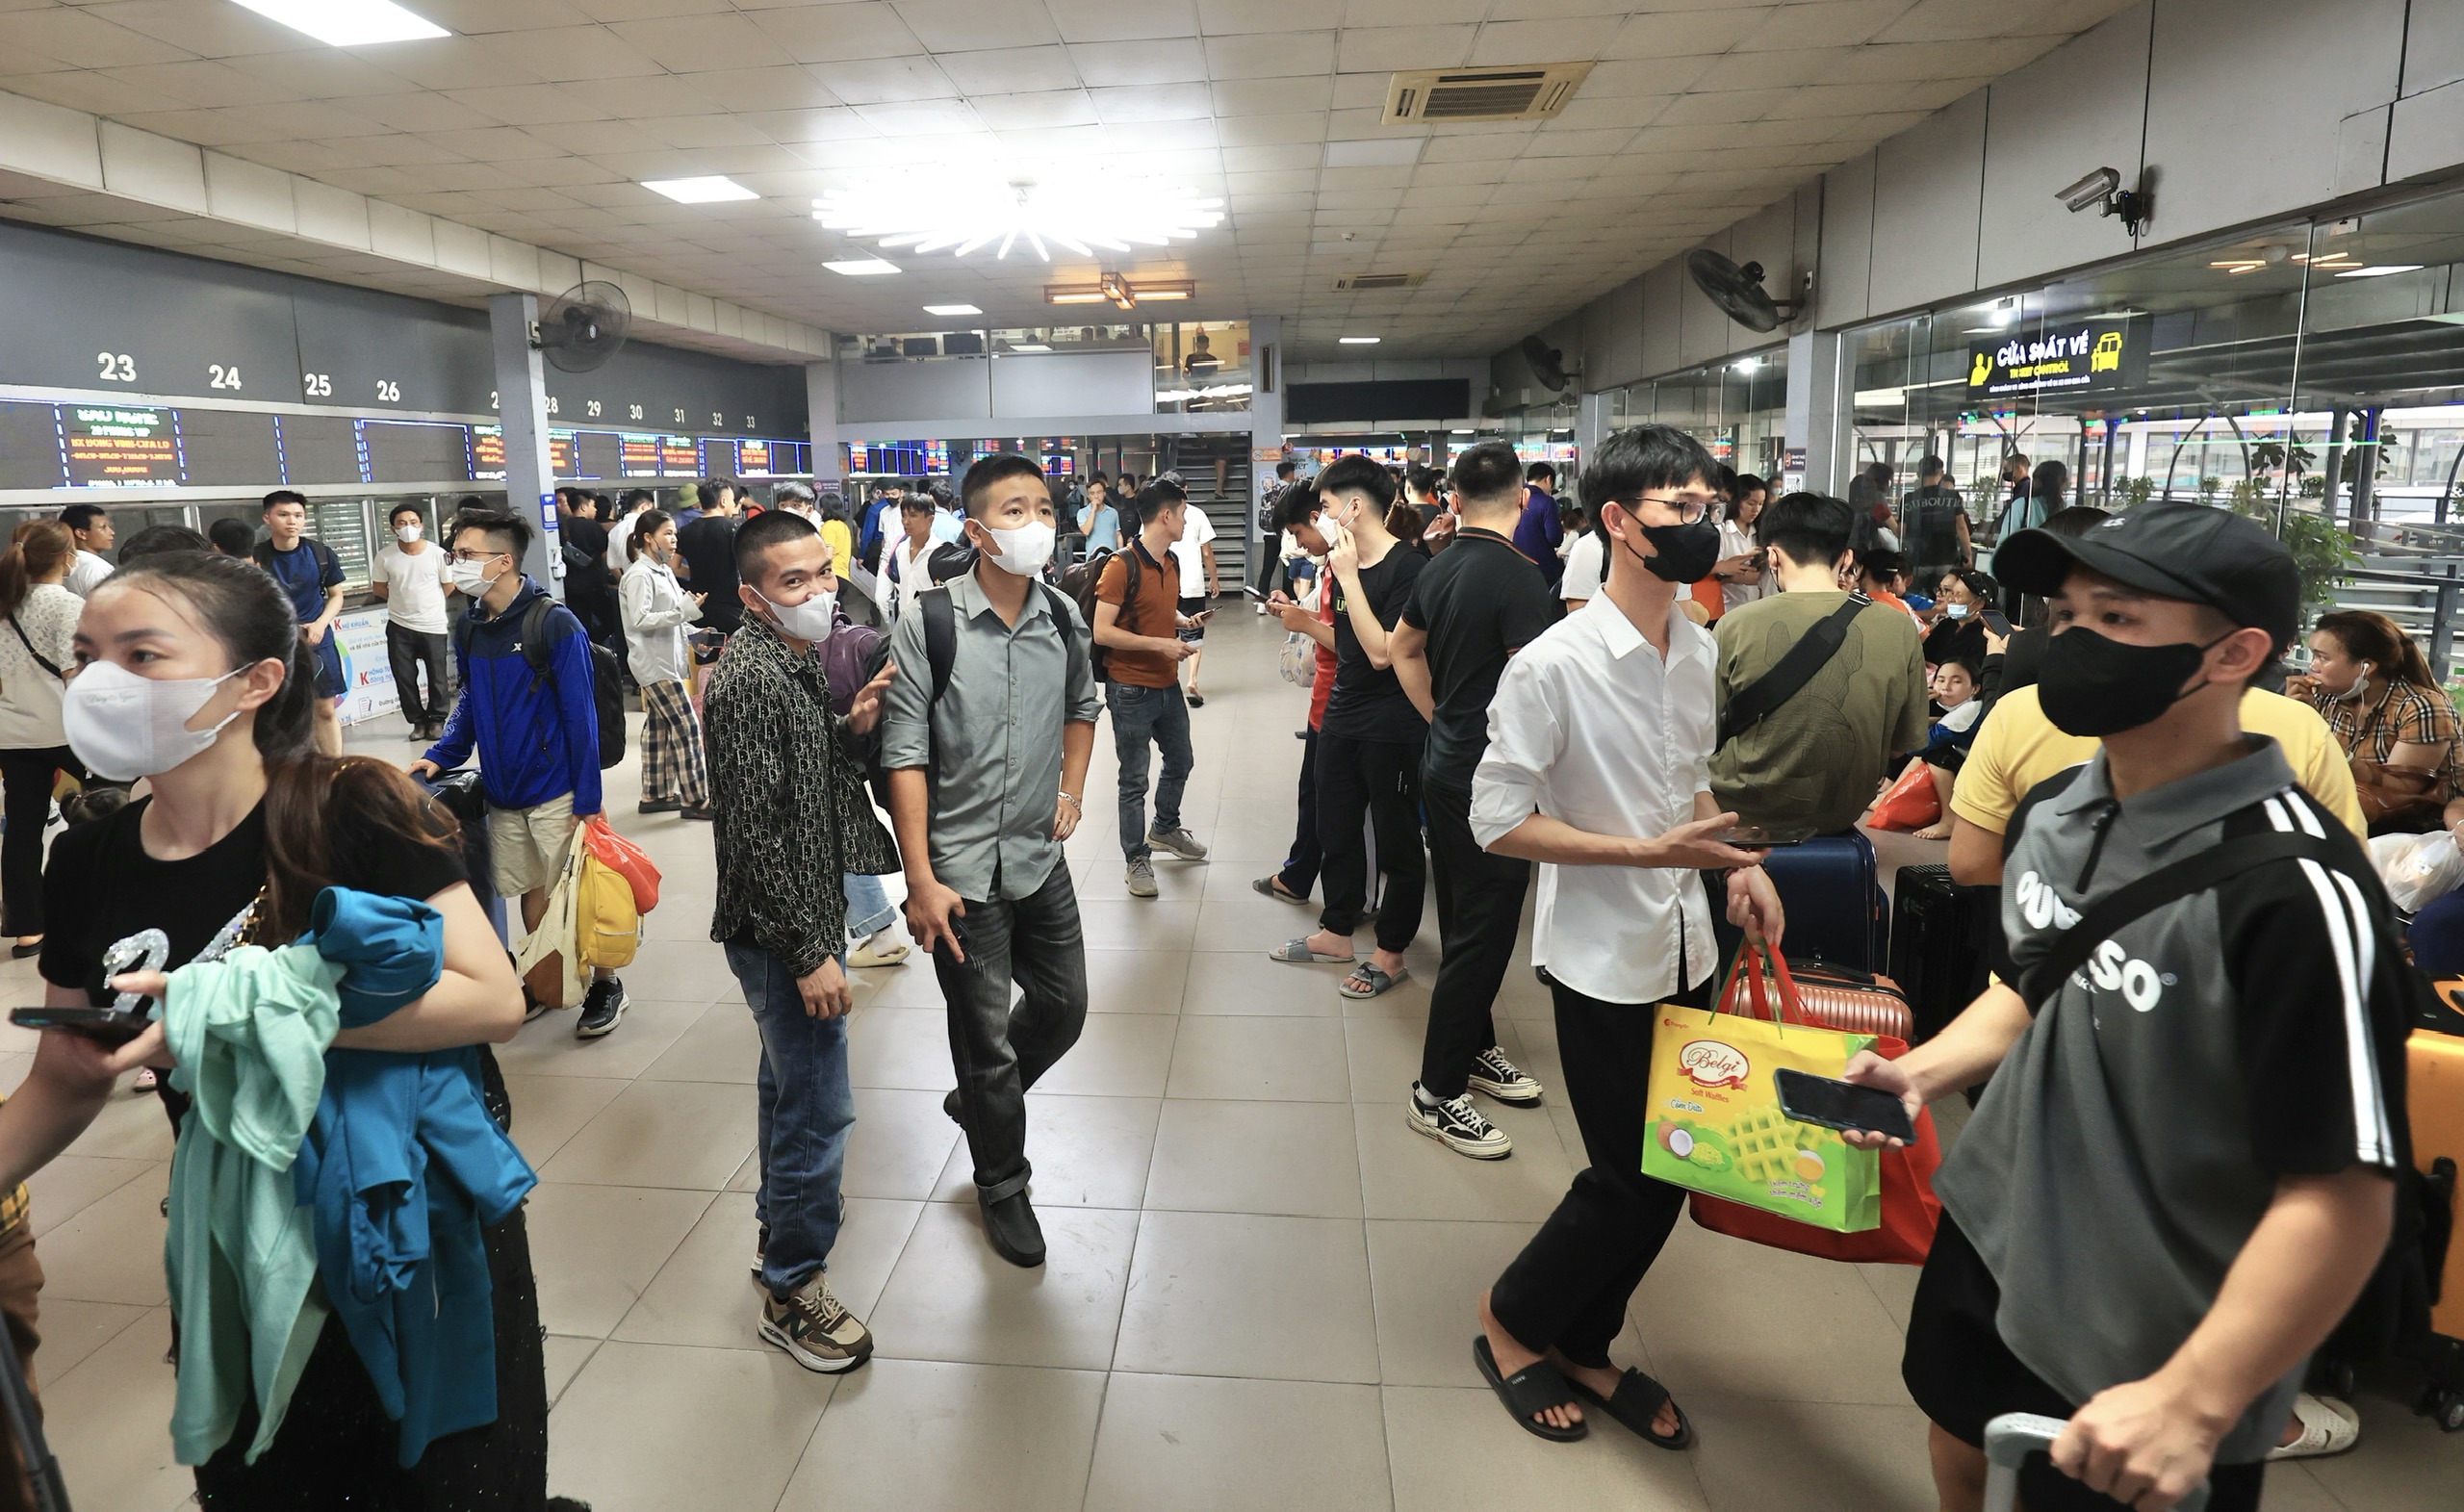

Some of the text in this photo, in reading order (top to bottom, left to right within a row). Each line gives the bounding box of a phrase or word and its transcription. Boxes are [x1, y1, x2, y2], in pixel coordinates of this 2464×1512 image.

[2069, 329, 2089, 356] VÉ
[97, 352, 137, 382] 23
[209, 364, 242, 390] 24
[305, 373, 332, 397] 25
[376, 380, 400, 401] 26
[491, 391, 500, 409] 2
[545, 397, 558, 414] 28
[587, 400, 602, 417] 29
[629, 404, 643, 420] 30
[675, 408, 685, 423] 31
[712, 412, 723, 426] 32
[746, 415, 756, 429] 33
[1686, 1047, 1741, 1077] Belgi
[1691, 1088, 1730, 1104] Soft Waffles
